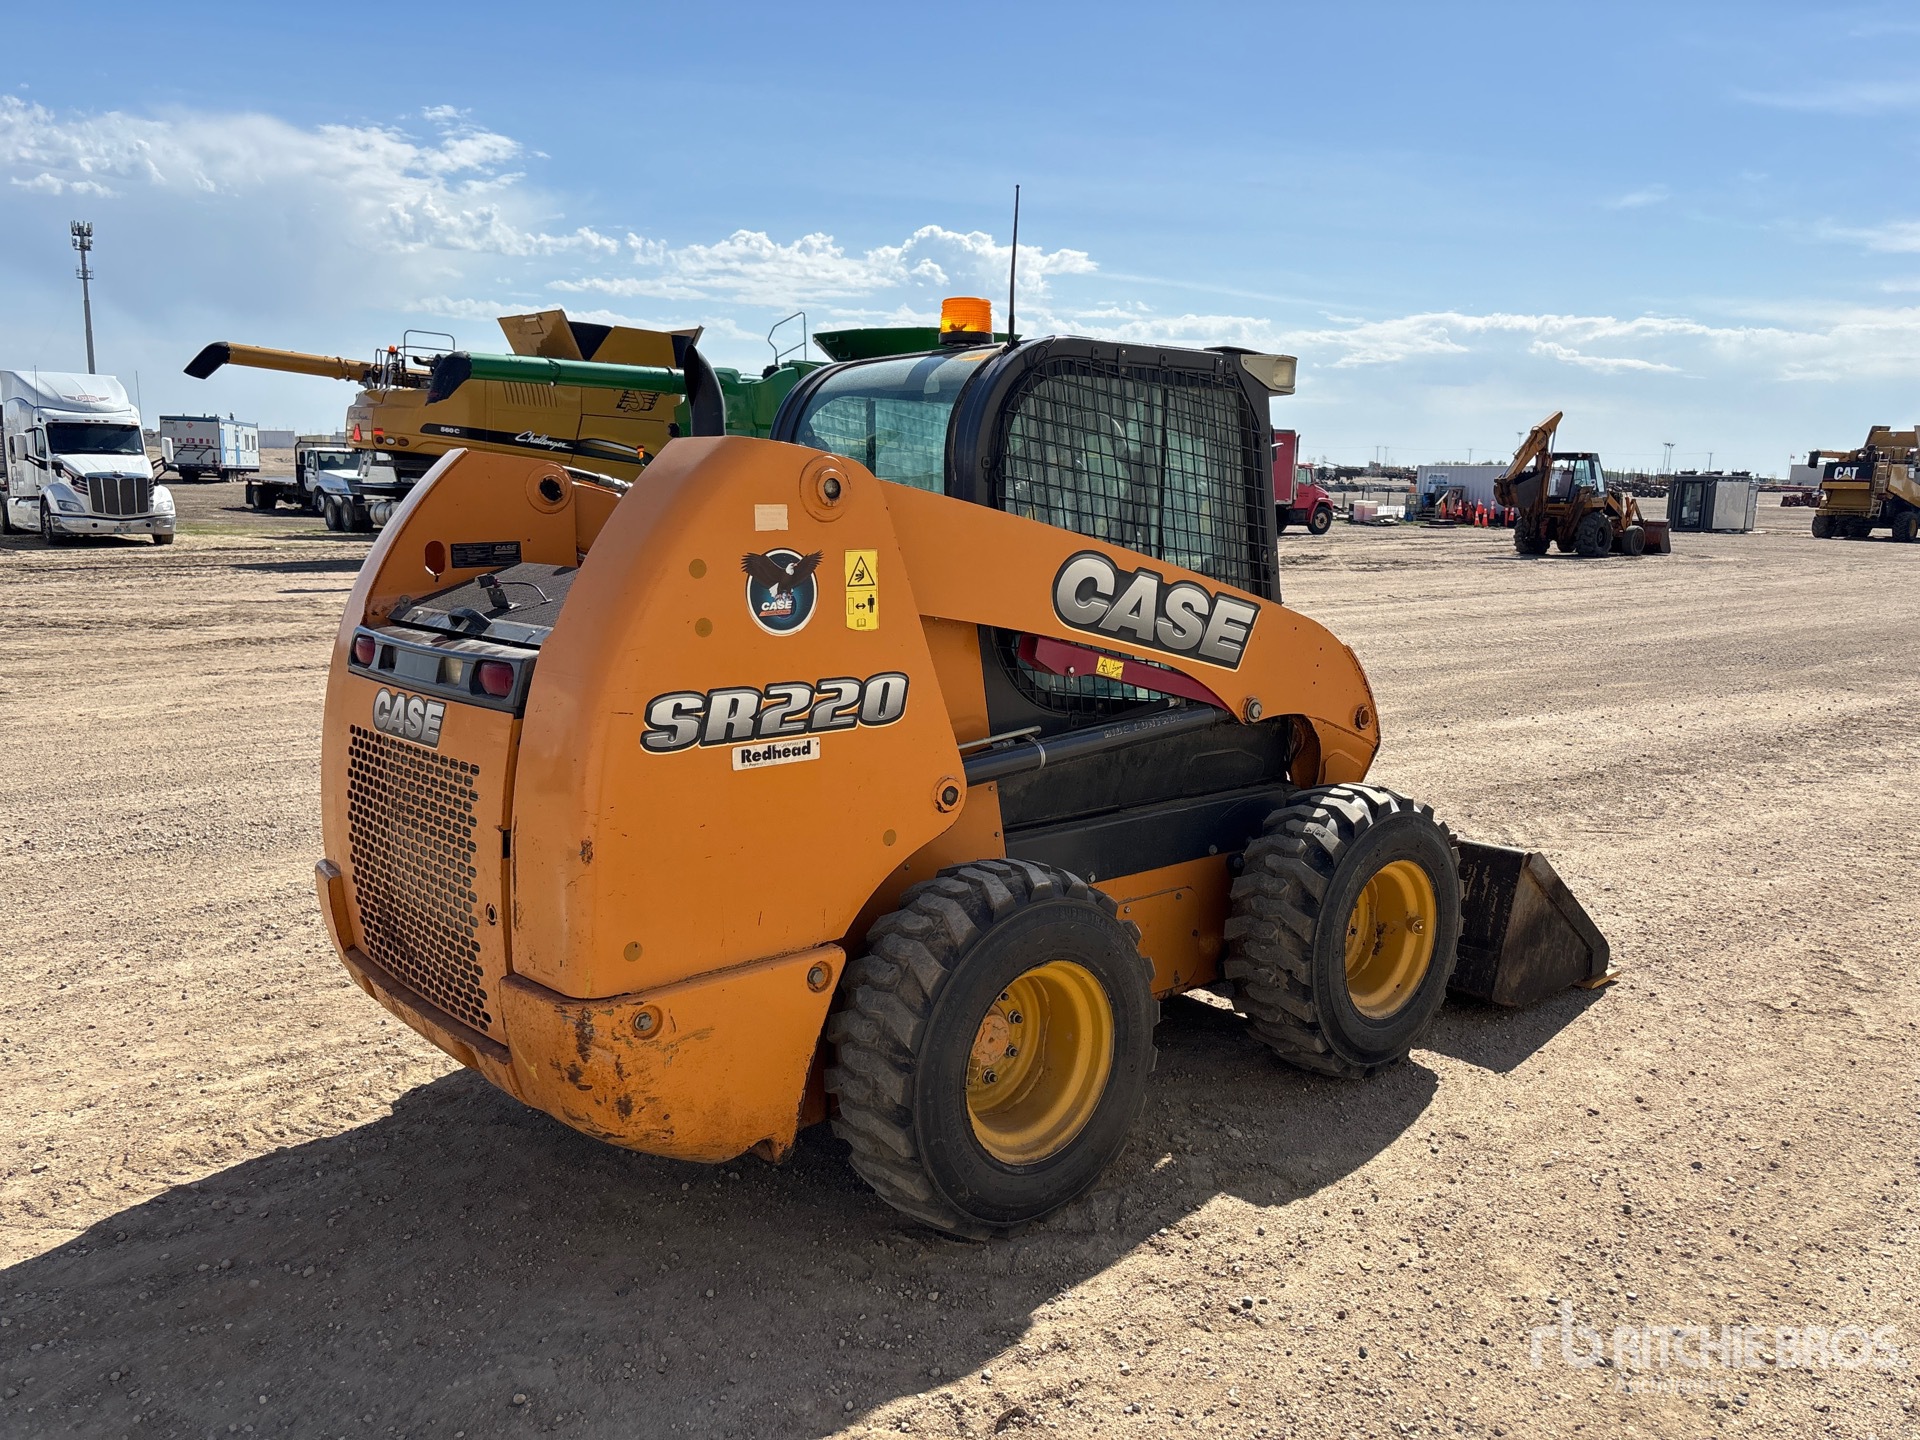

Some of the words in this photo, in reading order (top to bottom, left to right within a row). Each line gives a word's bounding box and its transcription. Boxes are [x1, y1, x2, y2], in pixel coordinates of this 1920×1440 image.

[514, 430, 573, 451] Challenger
[1833, 466, 1860, 481] CAT
[761, 600, 793, 611] CASE
[1054, 554, 1258, 668] CASE
[373, 688, 445, 745] CASE
[641, 672, 908, 753] SR220
[740, 740, 811, 764] Redhead
